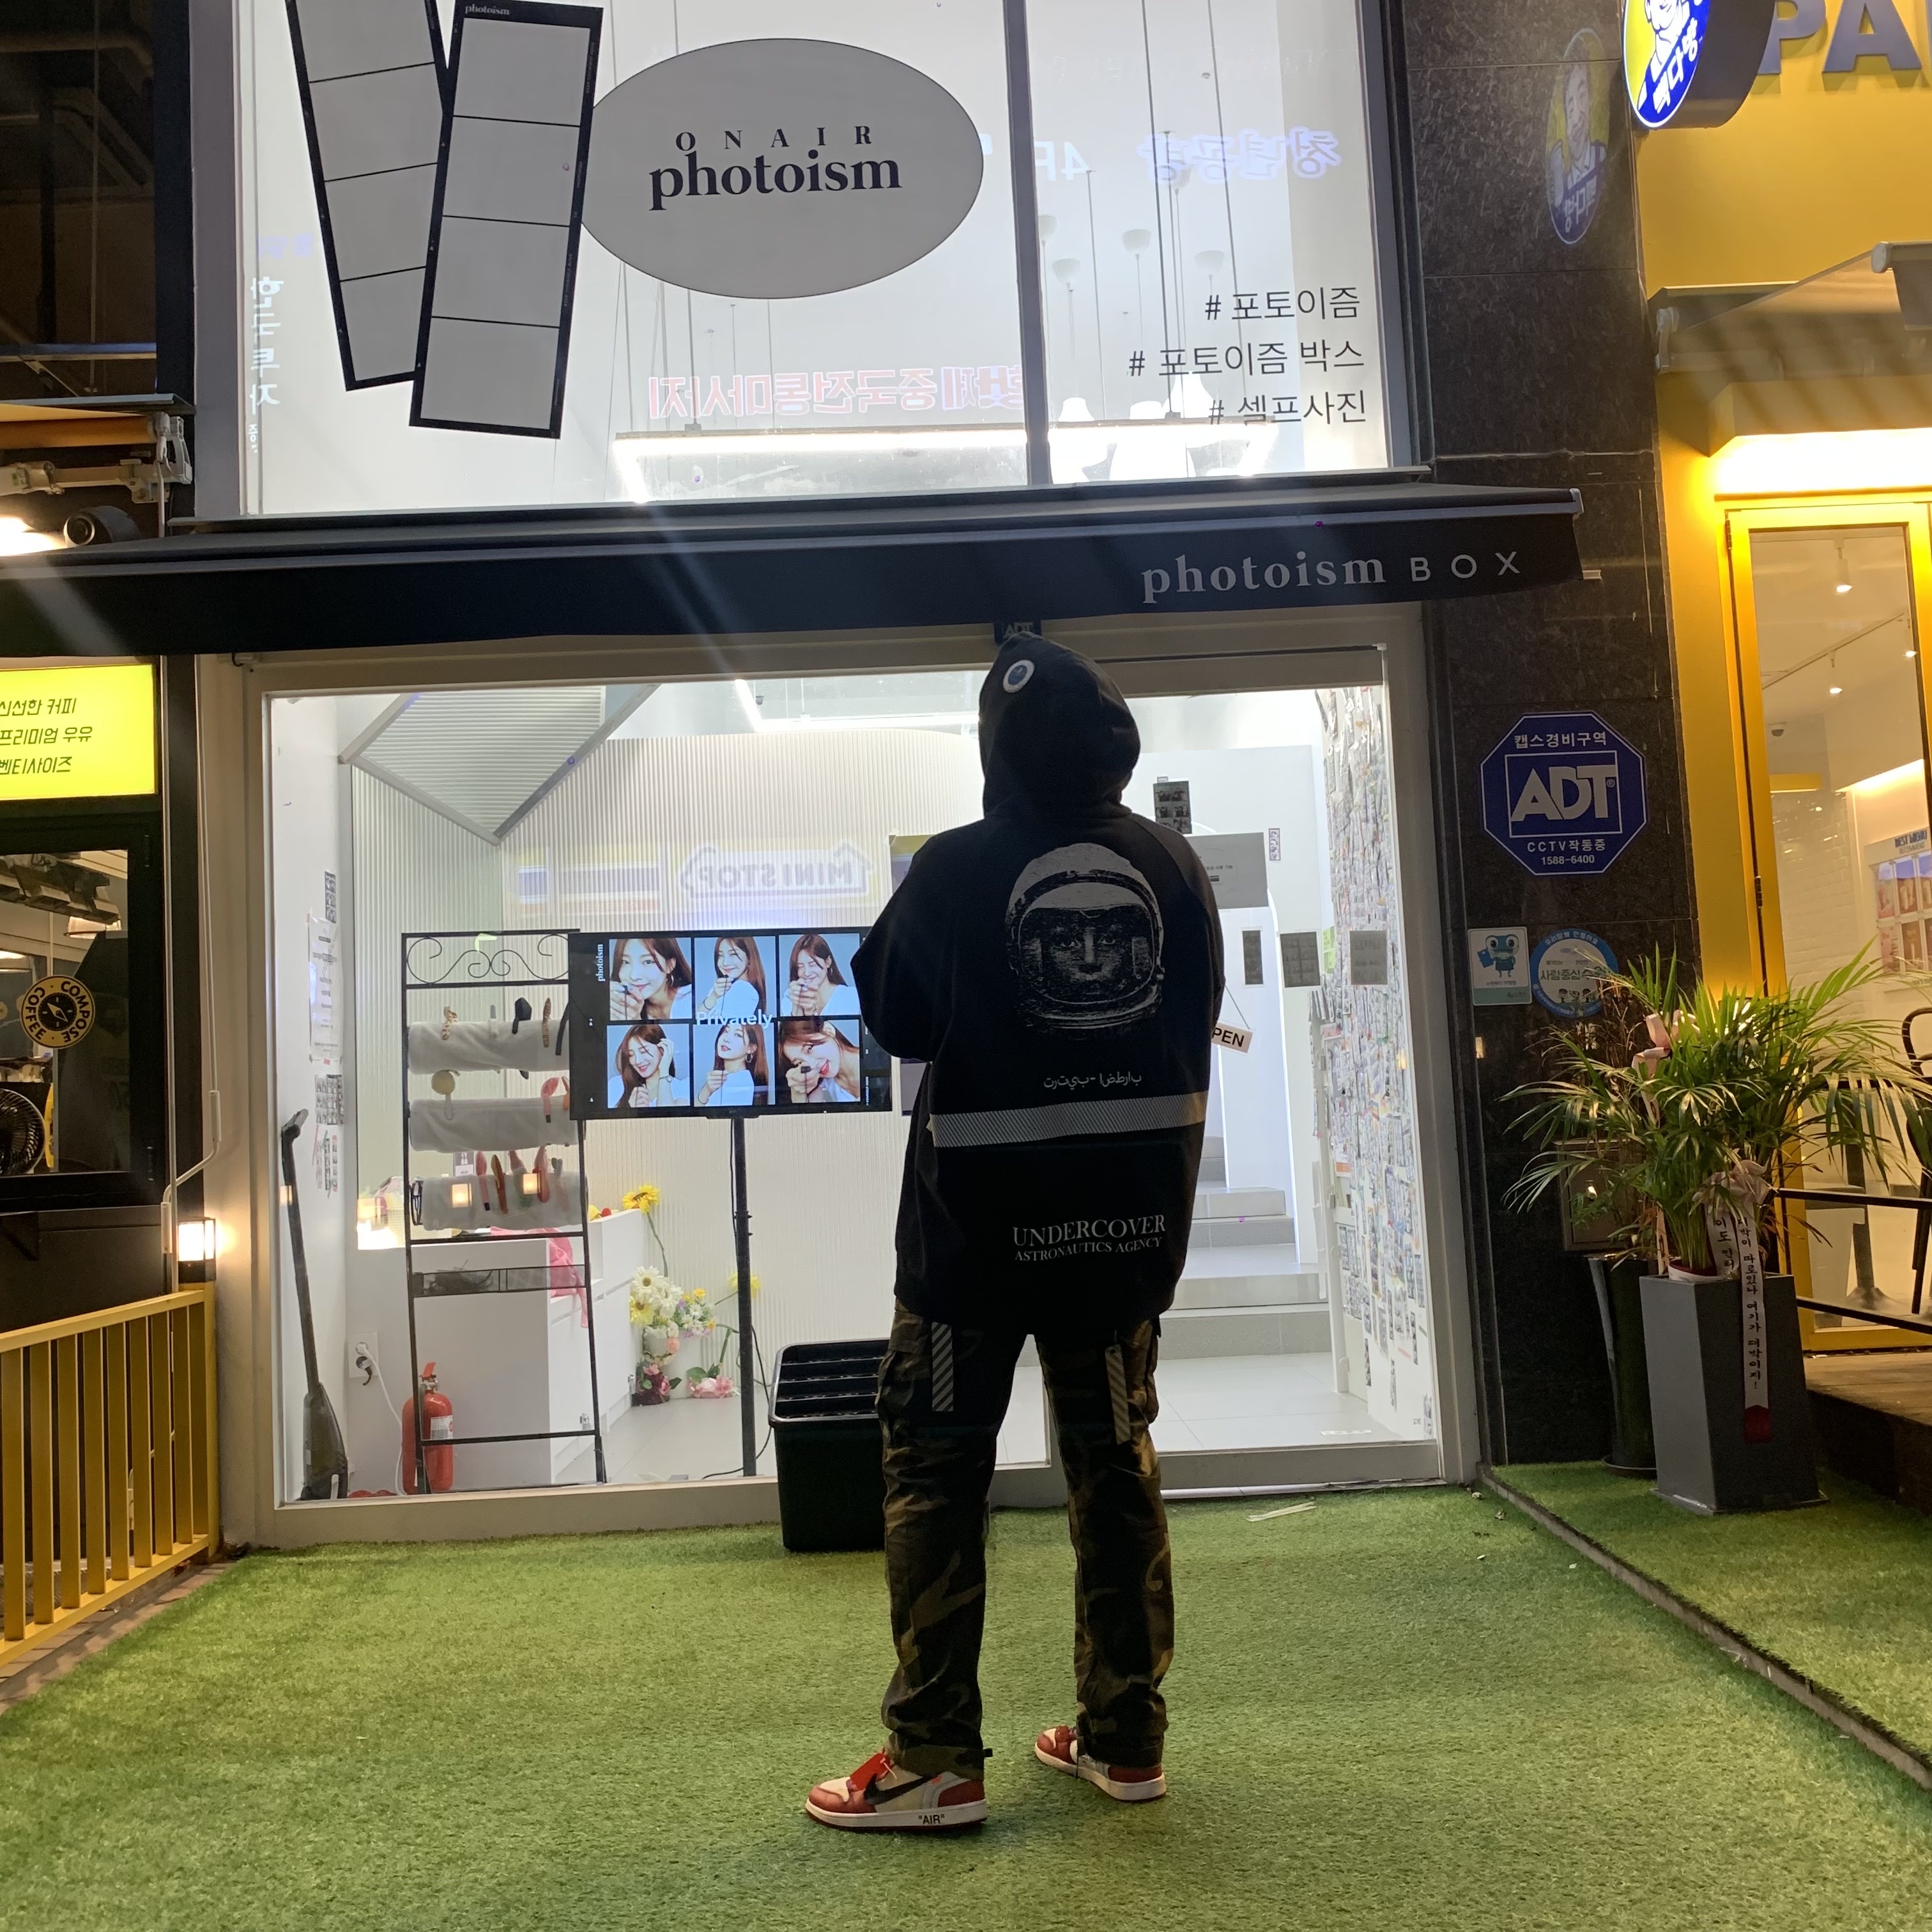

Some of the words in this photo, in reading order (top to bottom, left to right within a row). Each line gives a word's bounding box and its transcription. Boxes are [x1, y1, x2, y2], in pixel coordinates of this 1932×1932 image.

[465, 3, 510, 16] photoism
[1758, 0, 1932, 75] PA
[648, 149, 902, 211] photoism
[1206, 294, 1222, 320] #
[1231, 287, 1360, 320] 포토이즘
[1128, 350, 1145, 376] #
[1158, 342, 1287, 376] 포토이즘
[1300, 339, 1364, 372] 박스
[1208, 399, 1225, 425] #
[1141, 551, 1386, 604] photoism
[1410, 551, 1521, 583] BOX
[0, 699, 42, 716] 신선한
[47, 698, 77, 714] 커피
[0, 728, 59, 746] 프리미엄
[63, 726, 93, 742] 우유
[1514, 731, 1607, 749] 캡스경비구역
[1510, 765, 1616, 822] ADT
[1527, 839, 1606, 852] CCTV작동중
[1541, 854, 1595, 865] 1588-6400
[25, 986, 47, 1040] COFFEE
[61, 981, 91, 1043] COMPOSE
[696, 1009, 774, 1026] Privately
[1211, 1027, 1245, 1047] PEN
[1013, 1215, 1166, 1246] UNDERCOVER
[1015, 1242, 1112, 1261] ASTRONAUTICS
[1116, 1237, 1162, 1253] AGENCY
[1746, 1301, 1761, 1333] 여기가
[918, 1813, 946, 1825] "AIR"
